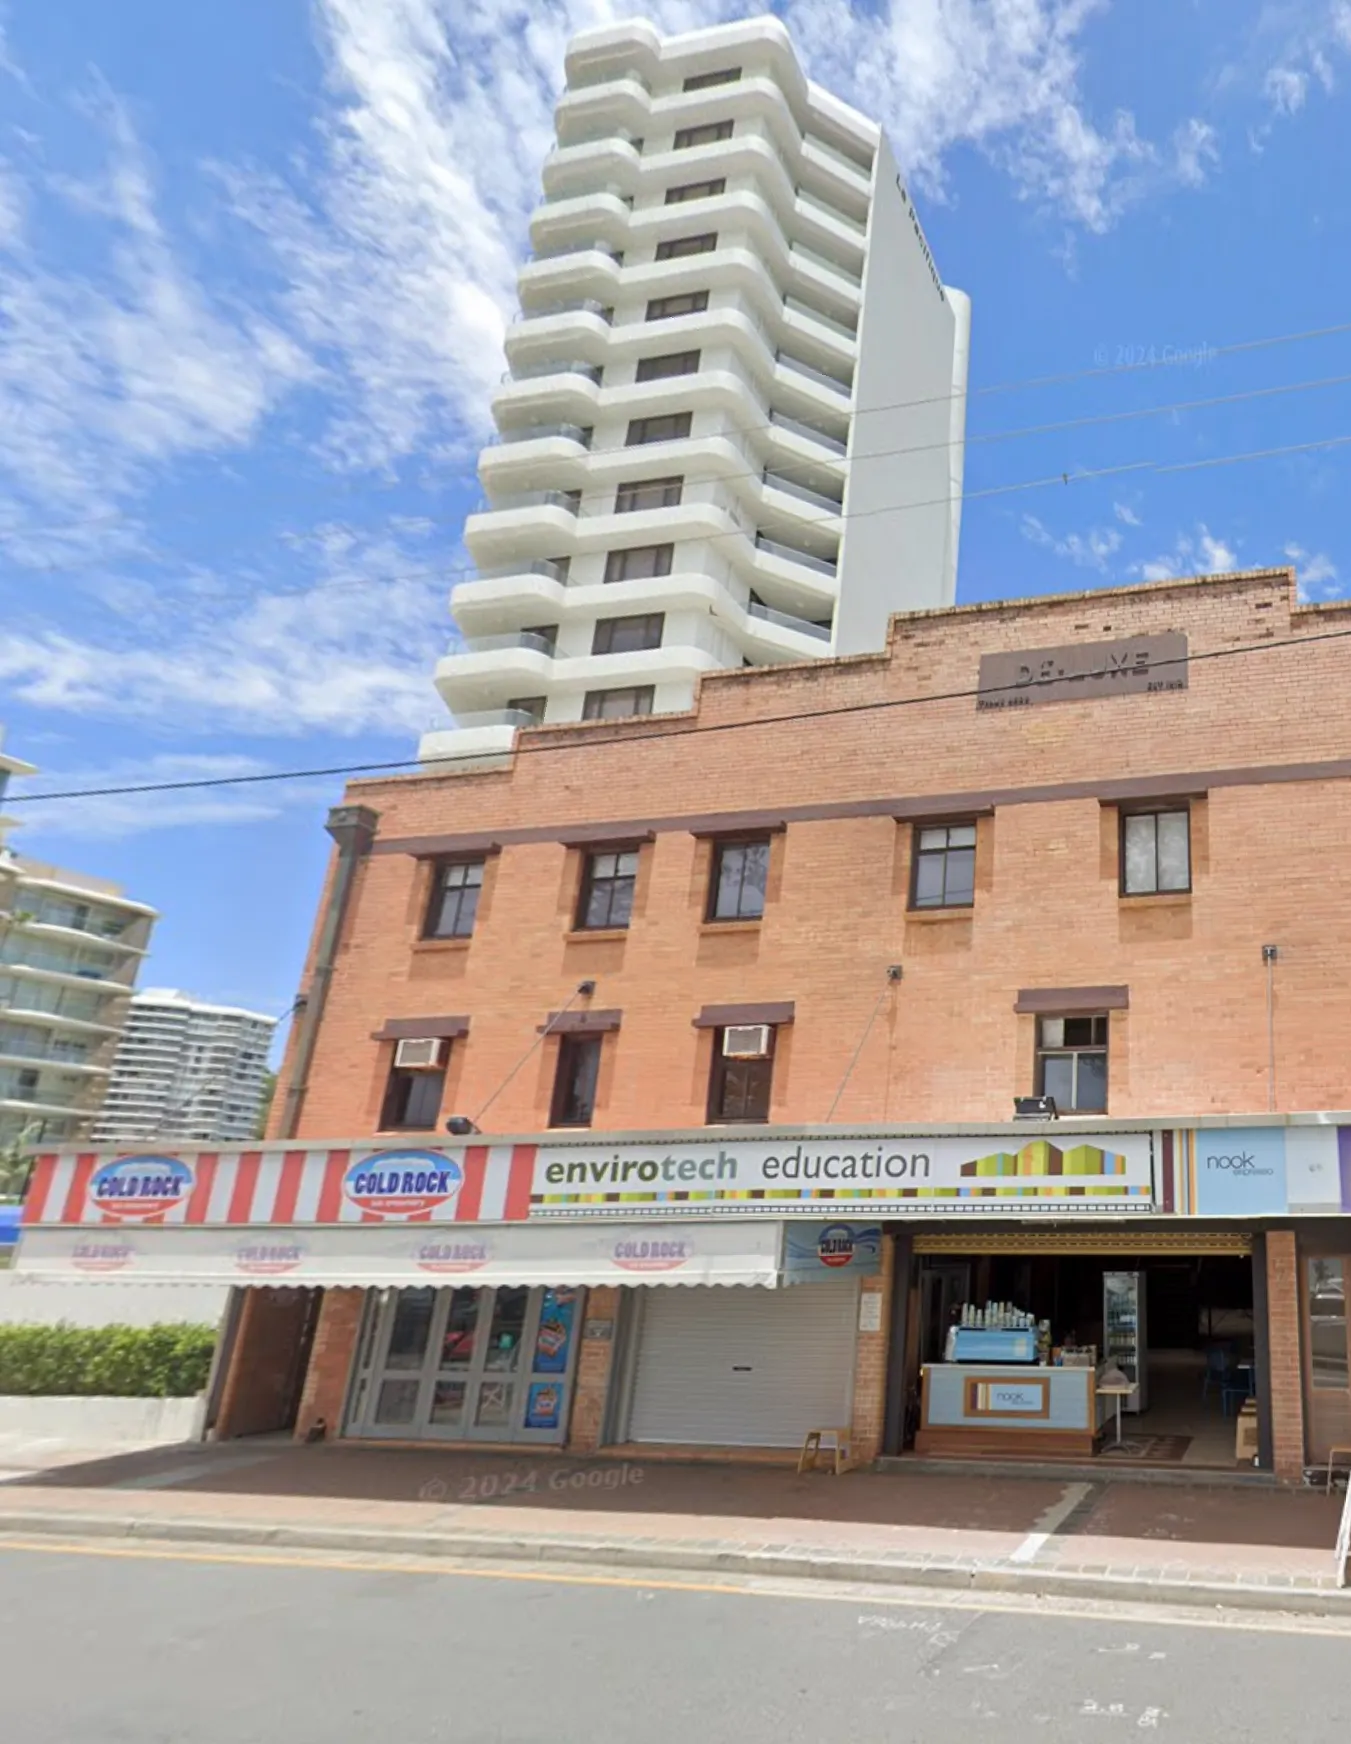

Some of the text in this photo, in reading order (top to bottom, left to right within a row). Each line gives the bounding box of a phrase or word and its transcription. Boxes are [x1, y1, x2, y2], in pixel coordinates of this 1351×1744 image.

[545, 1145, 930, 1184] envirotech education
[1206, 1150, 1255, 1169] nook
[354, 1170, 451, 1195] COLD ROCK
